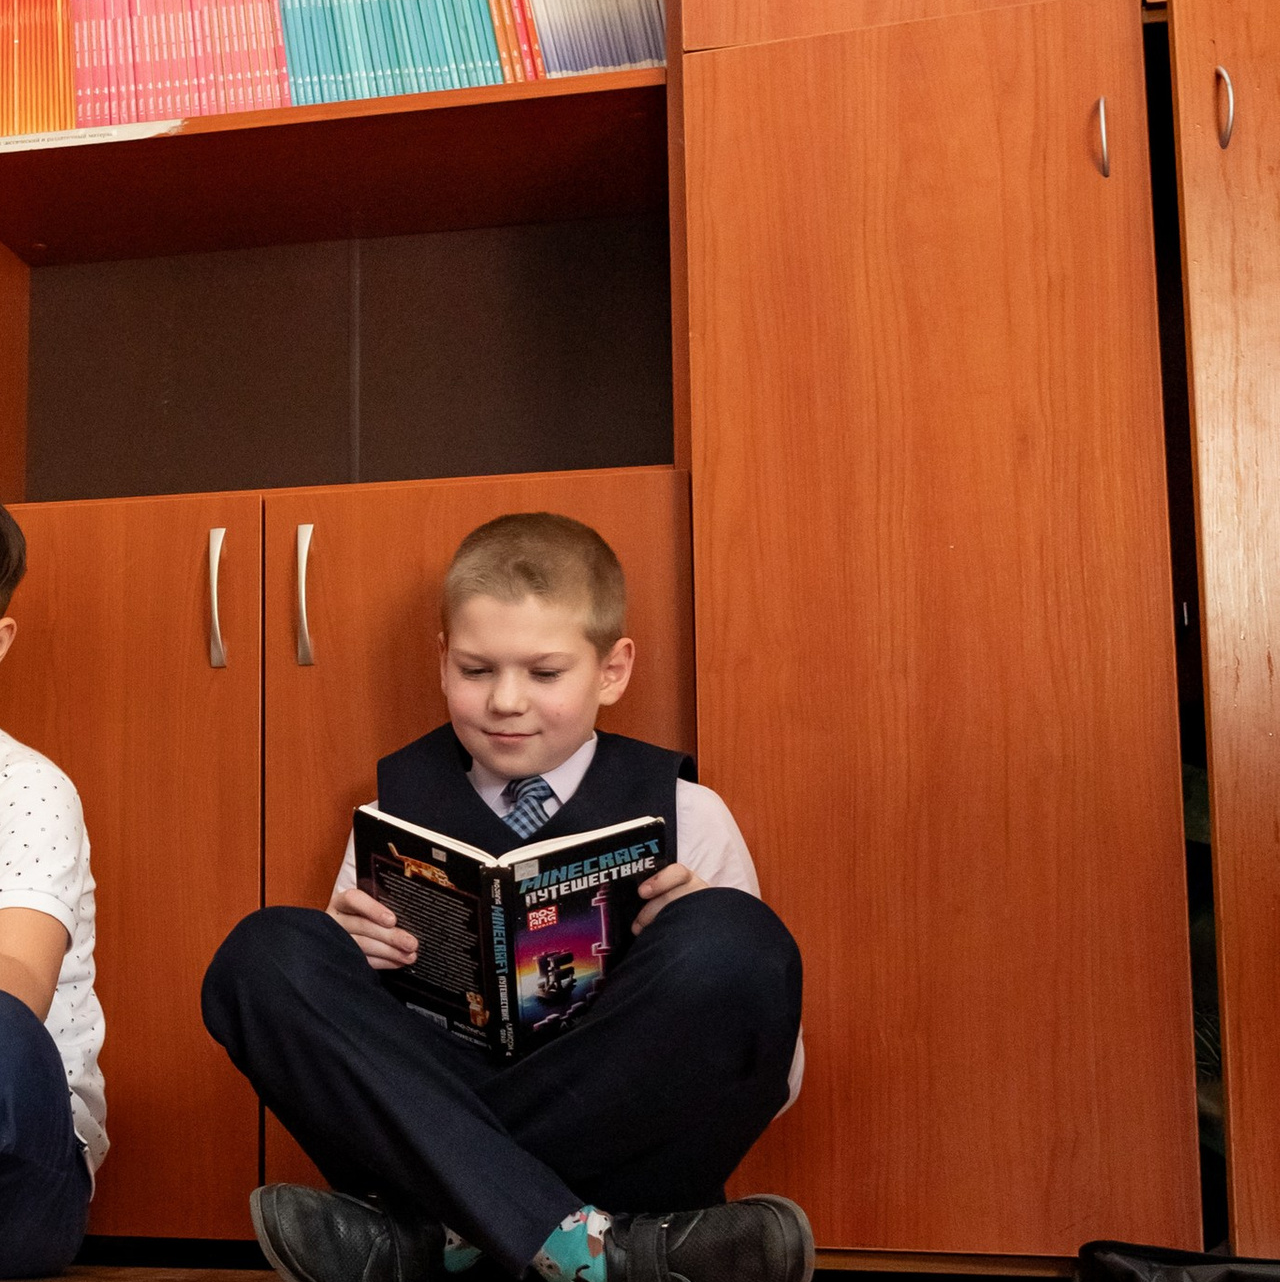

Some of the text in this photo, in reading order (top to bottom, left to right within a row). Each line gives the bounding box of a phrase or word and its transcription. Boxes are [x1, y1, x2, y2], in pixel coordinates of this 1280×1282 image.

[519, 839, 660, 894] MINECRAFT
[525, 856, 656, 908] ПУТЕШЕСТВИЕ
[491, 904, 509, 974] MINECRAFT
